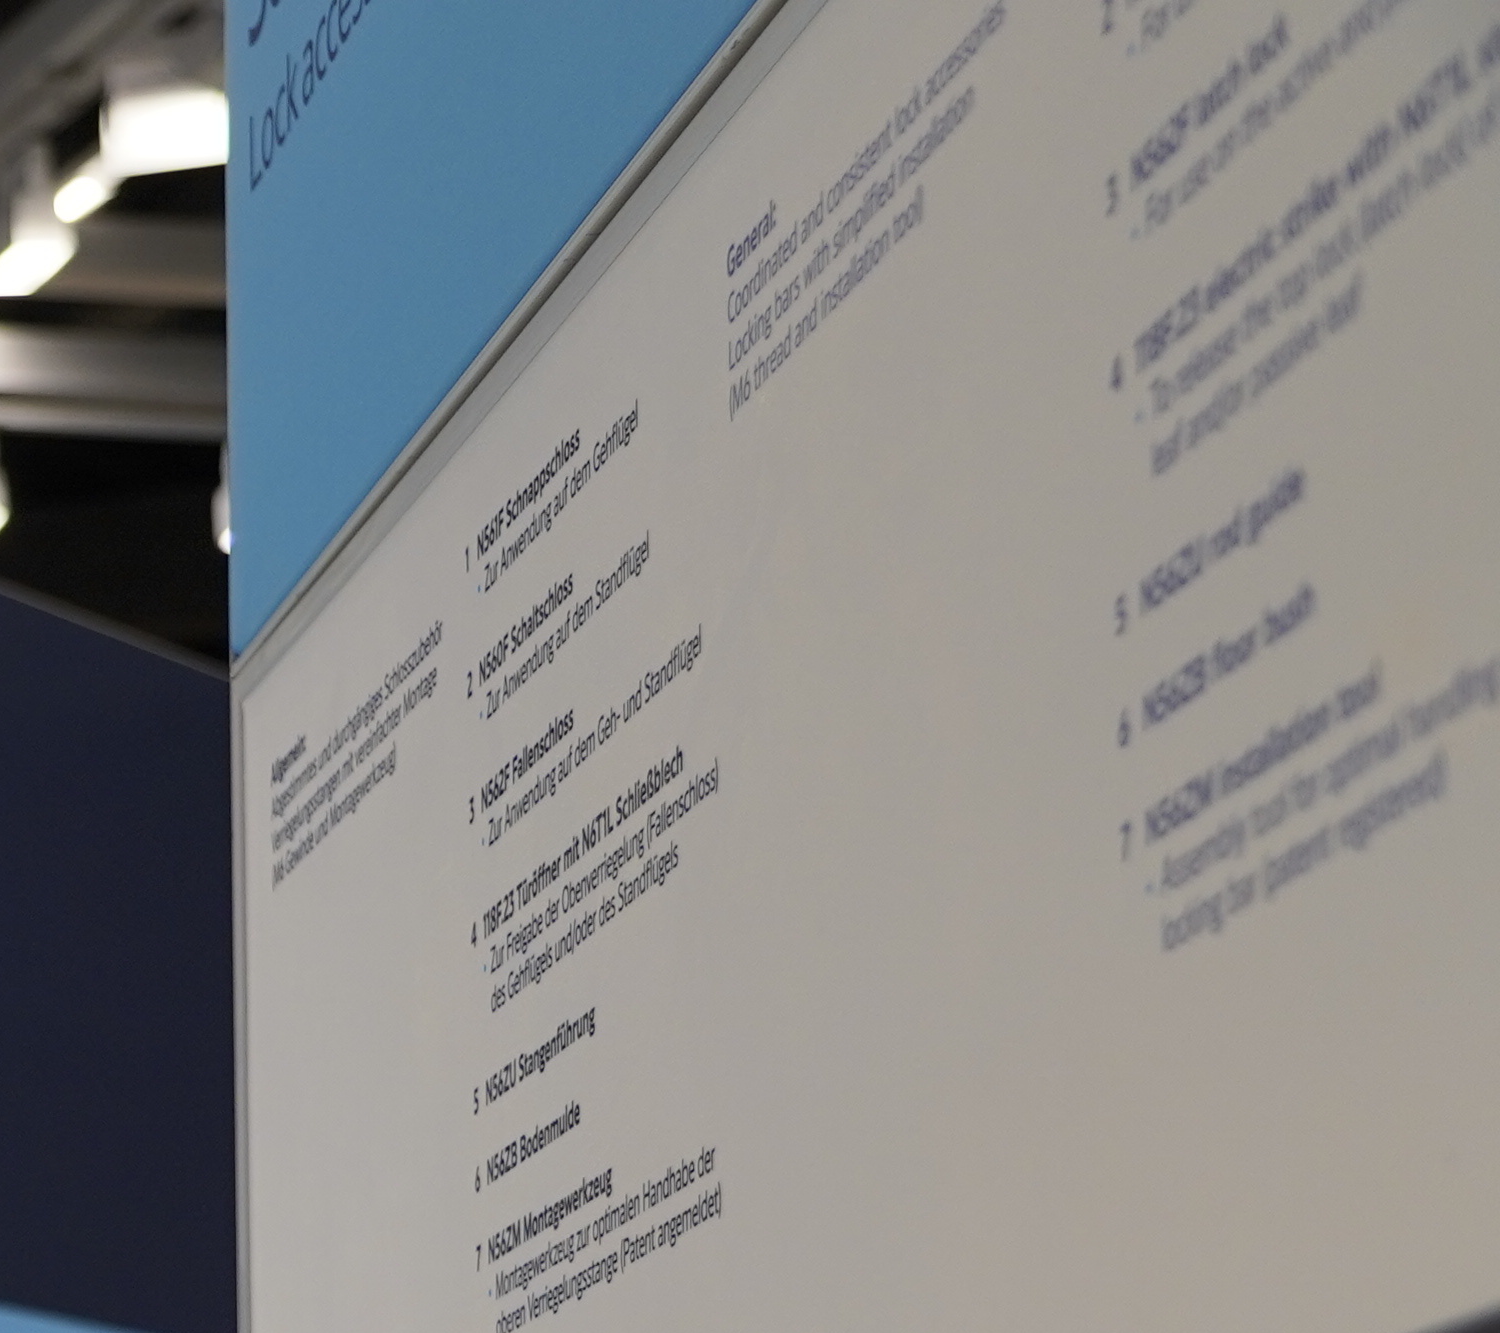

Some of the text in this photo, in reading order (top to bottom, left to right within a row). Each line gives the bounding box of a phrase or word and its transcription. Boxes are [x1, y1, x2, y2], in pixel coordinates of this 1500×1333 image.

[249, 53, 298, 191] Lock
[727, 199, 776, 277] General:
[728, 219, 797, 323] Coordinated
[801, 191, 823, 246] and
[826, 119, 893, 213] consistent
[895, 86, 920, 138] lock
[728, 304, 772, 371] Locking
[775, 272, 800, 321] bars
[802, 241, 830, 290] with
[832, 163, 895, 260] simplified
[465, 429, 580, 573] 1 N561F Schnappschloss
[484, 399, 638, 593] Zur Anwendung auf dem Gehflügel
[467, 573, 573, 700] 2 N560F Schaltschloss
[486, 530, 649, 719] Zur Anwendung auf dem Standflügel
[469, 709, 574, 824] 3 N562F Fallenschloss
[488, 623, 702, 847] Zur Anwendung auf dem Geh- und Standflügel
[471, 922, 476, 947] 4
[516, 859, 560, 910] Türöffner
[563, 836, 580, 872] mit
[616, 745, 683, 826] Schließblech
[490, 757, 718, 974] Zur Freigabe der Obenverriegelung (Fallenschloss)
[491, 841, 678, 1012] des Gehflügels und/oder des Standflügels
[474, 1087, 479, 1115] 5
[519, 1007, 595, 1082] Stangenführung
[475, 1166, 480, 1193] 6
[520, 1100, 581, 1163] Bodenmulde
[476, 1244, 481, 1272] 7
[523, 1168, 613, 1238] Montagewerkzeug
[495, 1146, 715, 1299] Montagewerkzeug zur optimalen Handhabe der
[528, 1249, 618, 1321] Verriegelungsstange
[621, 1225, 655, 1274] (Patent
[658, 1182, 722, 1247] angemeldet)
